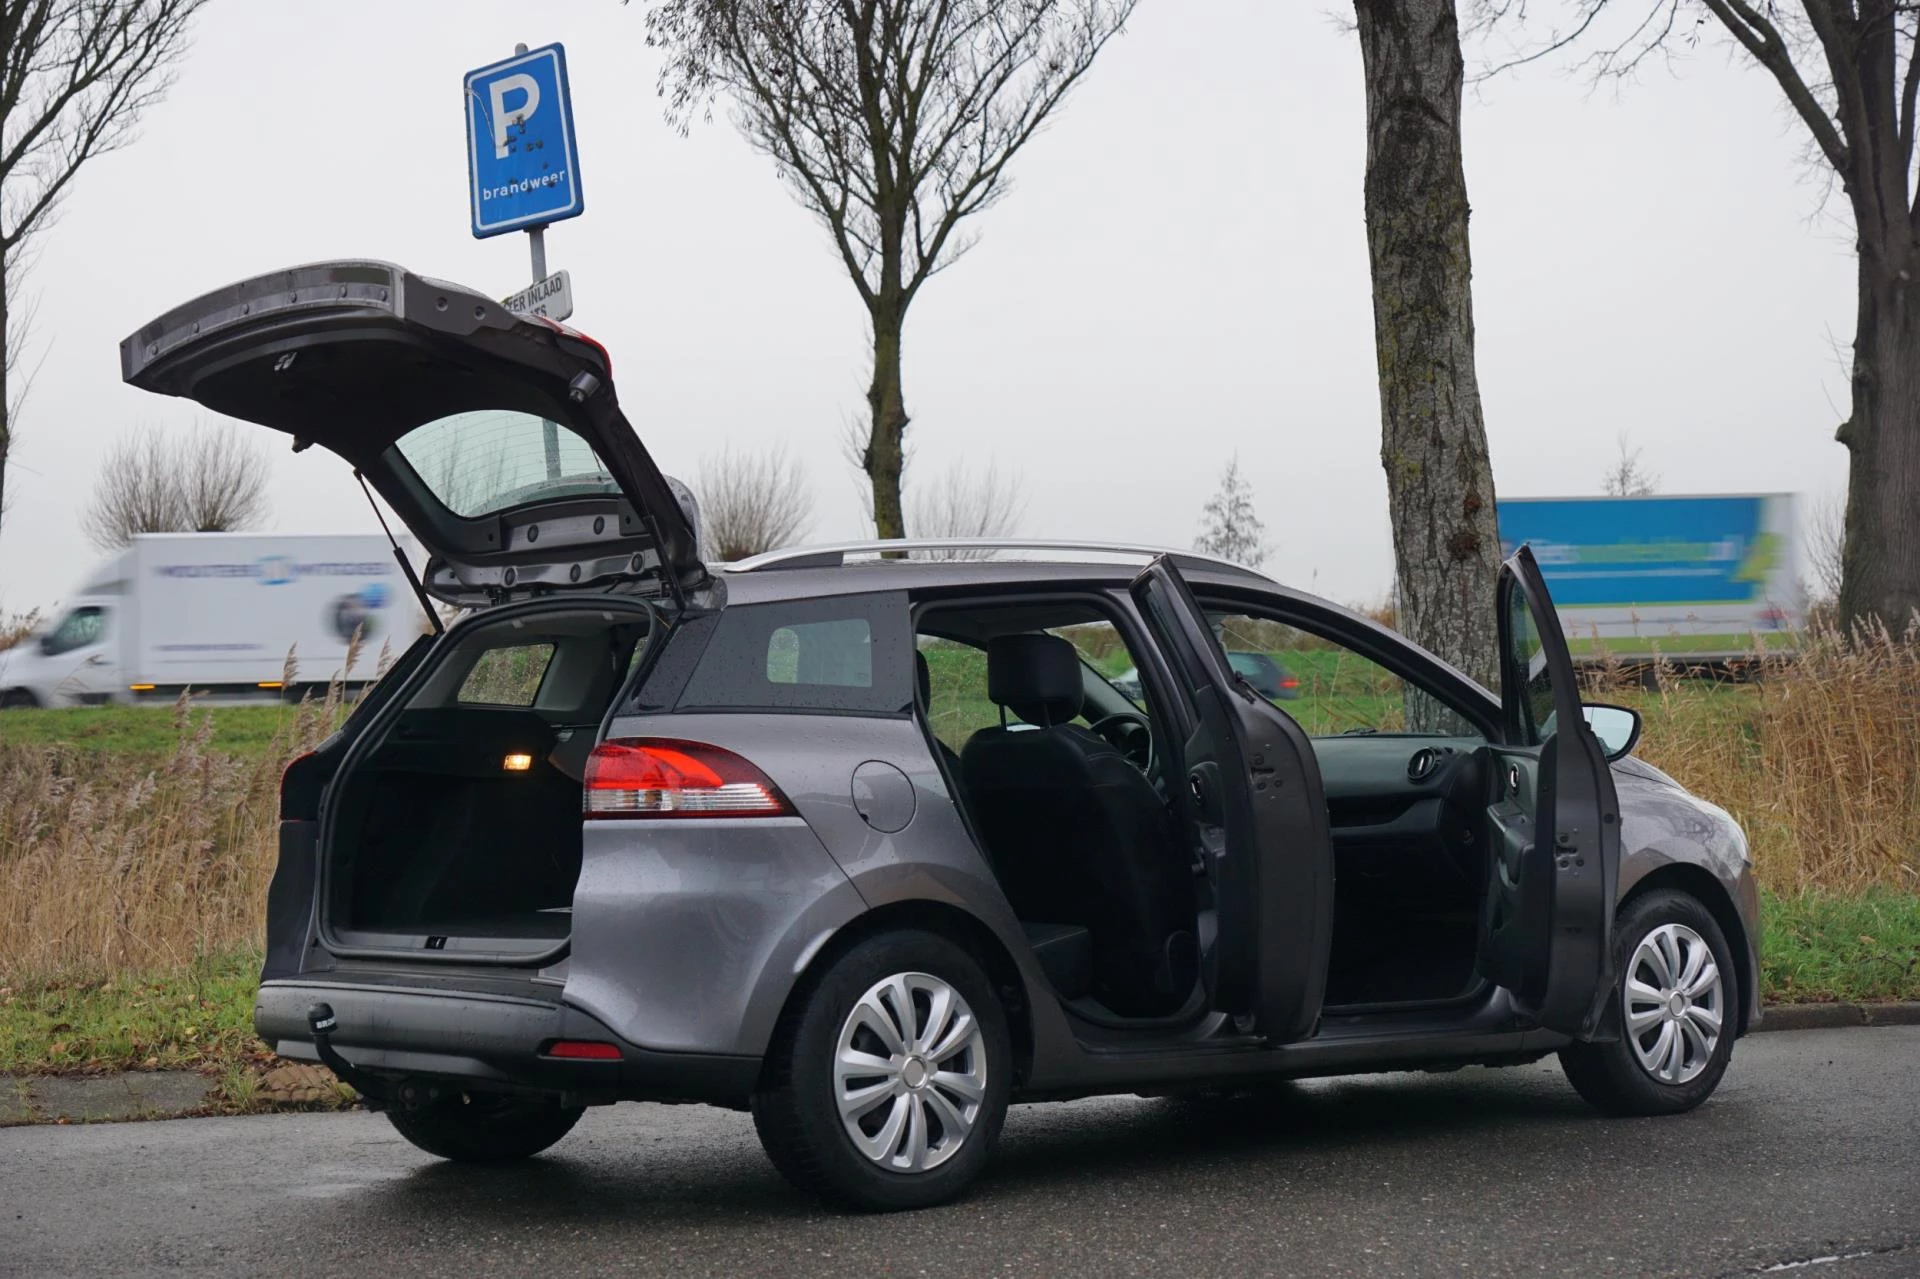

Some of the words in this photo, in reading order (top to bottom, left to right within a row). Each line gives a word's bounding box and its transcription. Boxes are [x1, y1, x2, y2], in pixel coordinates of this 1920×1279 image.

[489, 73, 540, 160] P
[483, 171, 565, 200] brandweer
[528, 277, 562, 307] INLAAD
